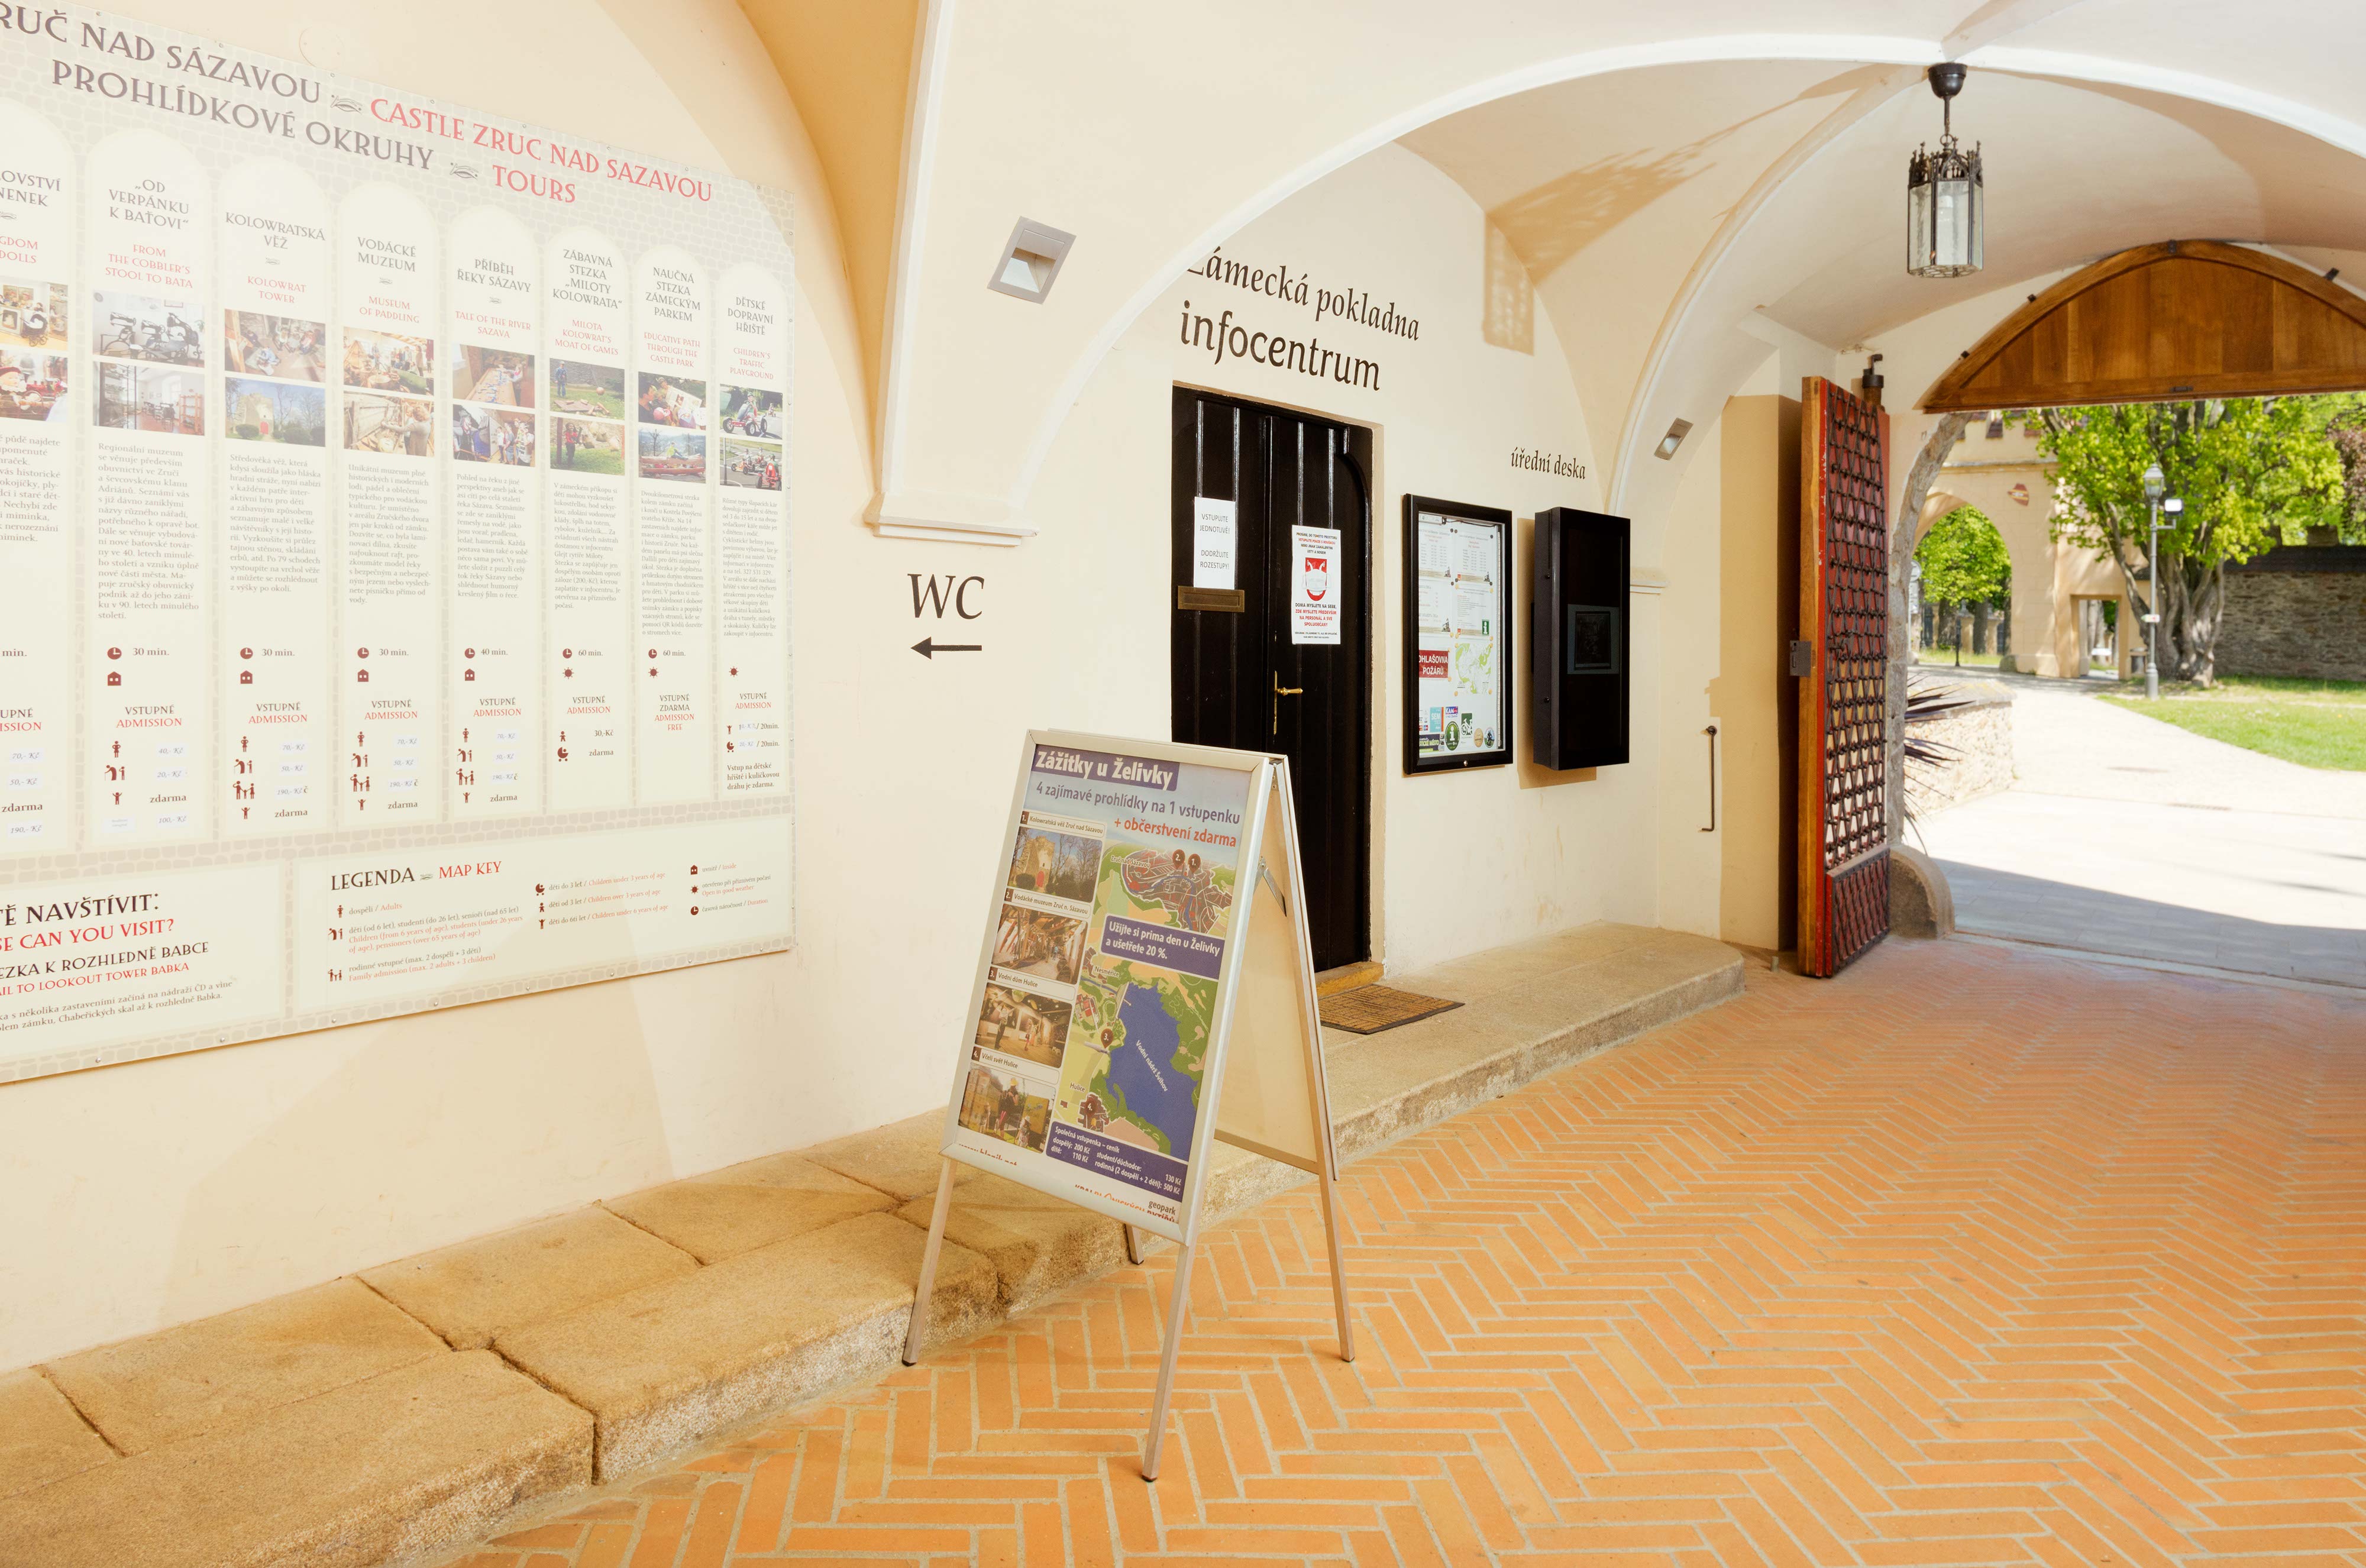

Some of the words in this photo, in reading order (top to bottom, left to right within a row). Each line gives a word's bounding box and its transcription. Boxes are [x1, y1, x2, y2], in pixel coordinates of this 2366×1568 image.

[82, 22, 154, 60] NAD
[167, 46, 321, 103] SÁZAVOU
[371, 98, 464, 141] CASTLE
[474, 122, 541, 159] ZRUC
[551, 143, 599, 174] NAD
[607, 159, 712, 202] SAZAVOU
[53, 59, 295, 138] PROHLÍDKOVÉ
[305, 121, 434, 170] OKRUHY
[493, 164, 575, 203] TOURS
[109, 189, 189, 214] VERPÁNKU
[110, 206, 119, 219] K
[226, 212, 325, 241] KOLOWRATSKÁ
[133, 244, 166, 257] FROM
[264, 235, 289, 250] VĚŽ
[358, 237, 416, 257] VODÁCKÉ
[108, 254, 129, 264] THE
[132, 258, 190, 274] COBBLER'S
[358, 251, 415, 272] MUZEUM
[563, 248, 613, 267] ZÁBAVNÁ
[475, 258, 514, 276] PŘÍBĚH
[570, 264, 606, 280] STEZKA
[653, 267, 694, 283] NAUČNÁ
[105, 267, 143, 280] STOOL
[147, 273, 161, 283] TO
[166, 276, 193, 289] BATA
[247, 276, 307, 293] KOLOWRAT
[457, 268, 485, 284] ŘEKY
[489, 275, 531, 292] SÁZAVY
[259, 290, 295, 303] TOWER
[657, 281, 691, 296] STEZKA
[1187, 246, 1308, 306] ámecká
[1315, 287, 1419, 341] pokladna
[645, 292, 700, 311] ZÁMECKÝM
[736, 296, 766, 311] DĚTSKÉ
[654, 307, 693, 322] PARKEM
[728, 308, 773, 324] DOPRAVNÍ
[736, 322, 765, 335] HŘIŠTĚ
[1181, 300, 1380, 391] infocentrum
[99, 442, 145, 454] Regionální
[148, 448, 183, 457] muzeum
[1511, 447, 1551, 473] úřední
[1554, 454, 1585, 479] deska
[17, 468, 60, 478] historické
[1202, 513, 1228, 522] VSTUPUJTE
[5, 523, 59, 532] nerozeznání
[1200, 525, 1230, 534] JEDNOTLIVĚ!
[1201, 549, 1228, 558] DODRŽUJTE
[907, 573, 984, 619] WC
[132, 648, 144, 656] 30
[147, 648, 170, 656] min.
[659, 693, 690, 701] VSTUPNÉ
[124, 704, 175, 715] VSTUPNÉ
[654, 713, 694, 722] ADMISSION
[115, 718, 183, 729] ADMISSION
[1036, 751, 1094, 780] Zážitky
[1097, 764, 1107, 777] u
[1112, 757, 1173, 791] Želivky
[149, 794, 187, 804] zdarma
[1036, 781, 1042, 794] 4
[1045, 785, 1092, 801] zajímavé
[1094, 793, 1148, 813] prohlídky
[1151, 802, 1165, 814] na
[1170, 801, 1175, 814] 1
[1179, 806, 1240, 825] vstupenku
[1030, 816, 1056, 826] Kolowratská
[1085, 825, 1103, 834] Sázavou
[1124, 817, 1191, 840] občerstvení
[1194, 830, 1237, 847] zdarma
[1131, 859, 1150, 869] Sázavou
[331, 867, 415, 891] LEGENDA
[439, 864, 472, 880] MAP
[476, 861, 502, 875] KEY
[26, 893, 159, 924] NAVŠTÍVIT:
[1014, 894, 1033, 903] Vodácké
[1034, 898, 1053, 907] muzeum
[1069, 906, 1088, 914] Sázavou
[20, 930, 62, 949] CAN
[69, 924, 114, 945] YOU
[119, 918, 174, 938] VISIT?
[1109, 921, 1132, 935] Užijte
[1133, 927, 1139, 936] si
[1141, 930, 1164, 942] prima
[1166, 934, 1181, 945] den
[1190, 937, 1220, 956] Želivky
[46, 961, 56, 974] K
[62, 946, 157, 972] ROZHLEDNĚ
[161, 942, 209, 959] BABCE
[1113, 939, 1145, 953] ušetřete
[1146, 945, 1156, 955] 20
[1158, 948, 1168, 959] %.
[17, 982, 35, 994] TO
[39, 974, 103, 992] LOOKOUT
[105, 968, 147, 984] TOWER
[151, 962, 190, 977] BABKA
[998, 972, 1011, 981] Vodní
[1012, 976, 1023, 984] dům
[1023, 978, 1038, 988] Hulice
[19, 1005, 59, 1020] několika
[62, 997, 115, 1012] zastaveními
[982, 1053, 993, 1061] Včelí
[1004, 1059, 1018, 1068] Hulice
[1136, 1040, 1148, 1059] Vodní
[1146, 1058, 1157, 1075] nádrž
[1155, 1072, 1168, 1092] Švihov
[1070, 1082, 1085, 1092] Hulice
[1055, 1126, 1076, 1139] Společná
[1077, 1134, 1101, 1147] vstupenka
[1106, 1143, 1120, 1153] ceník
[1051, 1146, 1062, 1155] dítě:
[1072, 1152, 1081, 1160] 110
[1082, 1155, 1088, 1163] Kč
[1095, 1161, 1114, 1172] rodinná
[1121, 1169, 1139, 1181] dospělí
[1163, 1183, 1173, 1193] 500
[1174, 1186, 1180, 1195] Kč
[1053, 1137, 1072, 1149] dospělý:
[1074, 1144, 1083, 1152] 200
[1097, 1152, 1142, 1172] student/důchodce:
[1165, 1174, 1174, 1183] 130
[1175, 1177, 1182, 1186] Kč
[1148, 1200, 1176, 1215] geopark
